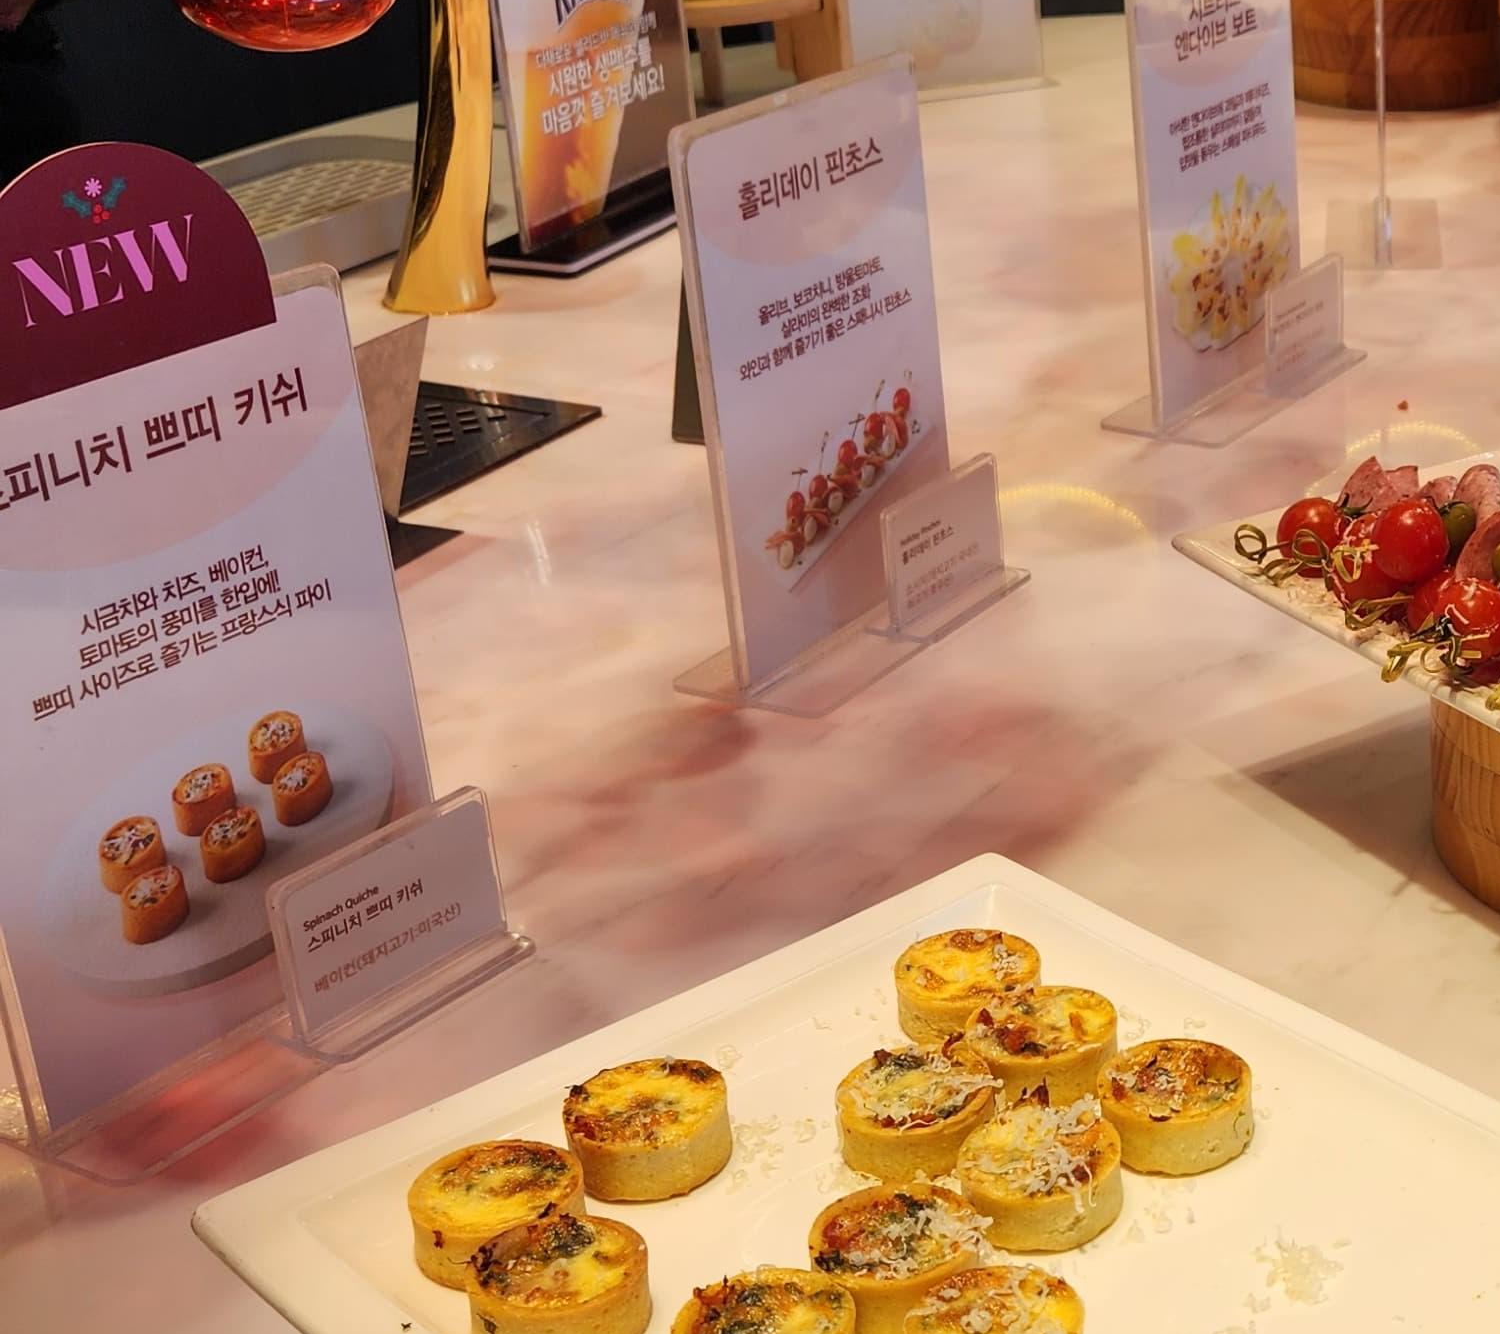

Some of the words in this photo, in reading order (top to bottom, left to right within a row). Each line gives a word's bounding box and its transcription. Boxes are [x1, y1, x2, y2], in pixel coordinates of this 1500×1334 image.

[550, 58, 594, 99] 시원한
[596, 36, 653, 83] 생맥주를
[1174, 18, 1228, 62] 엔다이브
[1231, 8, 1259, 39] 보트
[541, 95, 586, 135] 마음껏
[591, 63, 666, 121] 즐겨보세요!
[739, 157, 820, 221] 홀리데이
[824, 137, 883, 185] 핀초스
[12, 214, 193, 329] NEW
[821, 291, 851, 321] 완벽한
[851, 282, 872, 306] 조화
[739, 352, 771, 381] 와인과
[772, 341, 794, 367] 함께
[794, 328, 825, 357] 즐기기
[825, 317, 846, 342] 좋은
[884, 287, 913, 314] 핀초스
[144, 395, 221, 459] 쁘띠
[234, 367, 308, 426] 키쉬
[79, 618, 159, 670] 토마토의
[160, 594, 218, 637] 풍미를
[220, 569, 282, 612] 한입에!
[80, 587, 159, 636] 시금치와
[162, 572, 207, 603] 치즈,
[208, 544, 270, 584] 베이컨,
[32, 685, 76, 722] 쁘띠
[79, 652, 159, 701] 사이즈로
[160, 630, 218, 670] 즐기는
[221, 594, 293, 643] 프랑스식
[295, 578, 332, 611] 파이
[303, 903, 344, 932] Spinach
[344, 885, 380, 910] Quiche
[307, 911, 362, 954] 스피니치
[366, 894, 393, 921] 쁘띠
[396, 878, 423, 904] 키쉬
